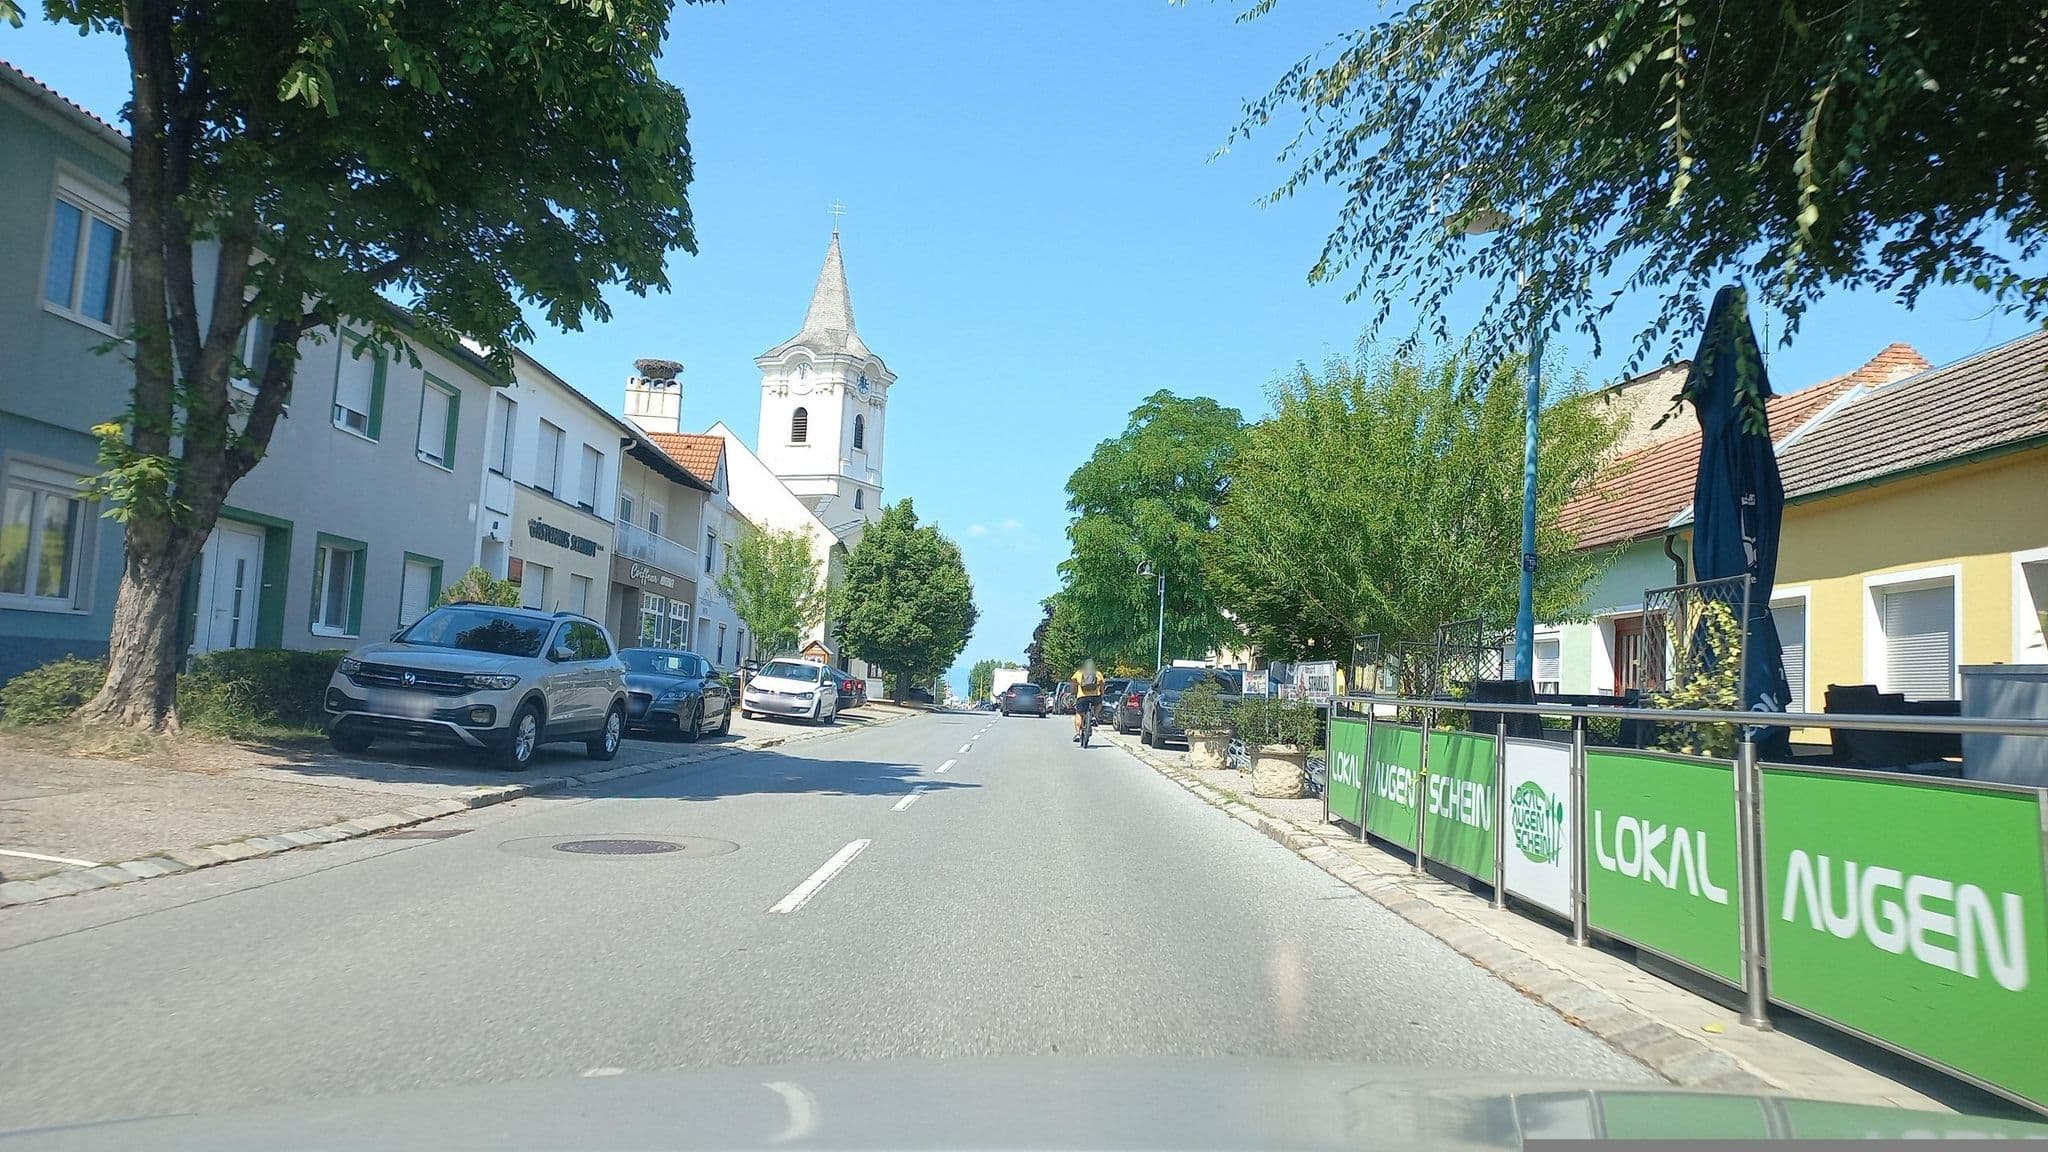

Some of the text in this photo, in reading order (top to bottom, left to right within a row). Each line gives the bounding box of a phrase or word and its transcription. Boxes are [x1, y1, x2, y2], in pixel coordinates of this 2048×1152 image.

[1332, 751, 1361, 789] LOKAL
[1372, 761, 1417, 808] AUGEN
[1429, 773, 1492, 832] SCHEIN
[1510, 785, 1542, 811] LOKAL
[1511, 807, 1544, 833] AUGEN
[1516, 829, 1551, 857] SCHEIN
[1594, 809, 1729, 905] LOKAL
[1781, 849, 2028, 992] AUGEN
